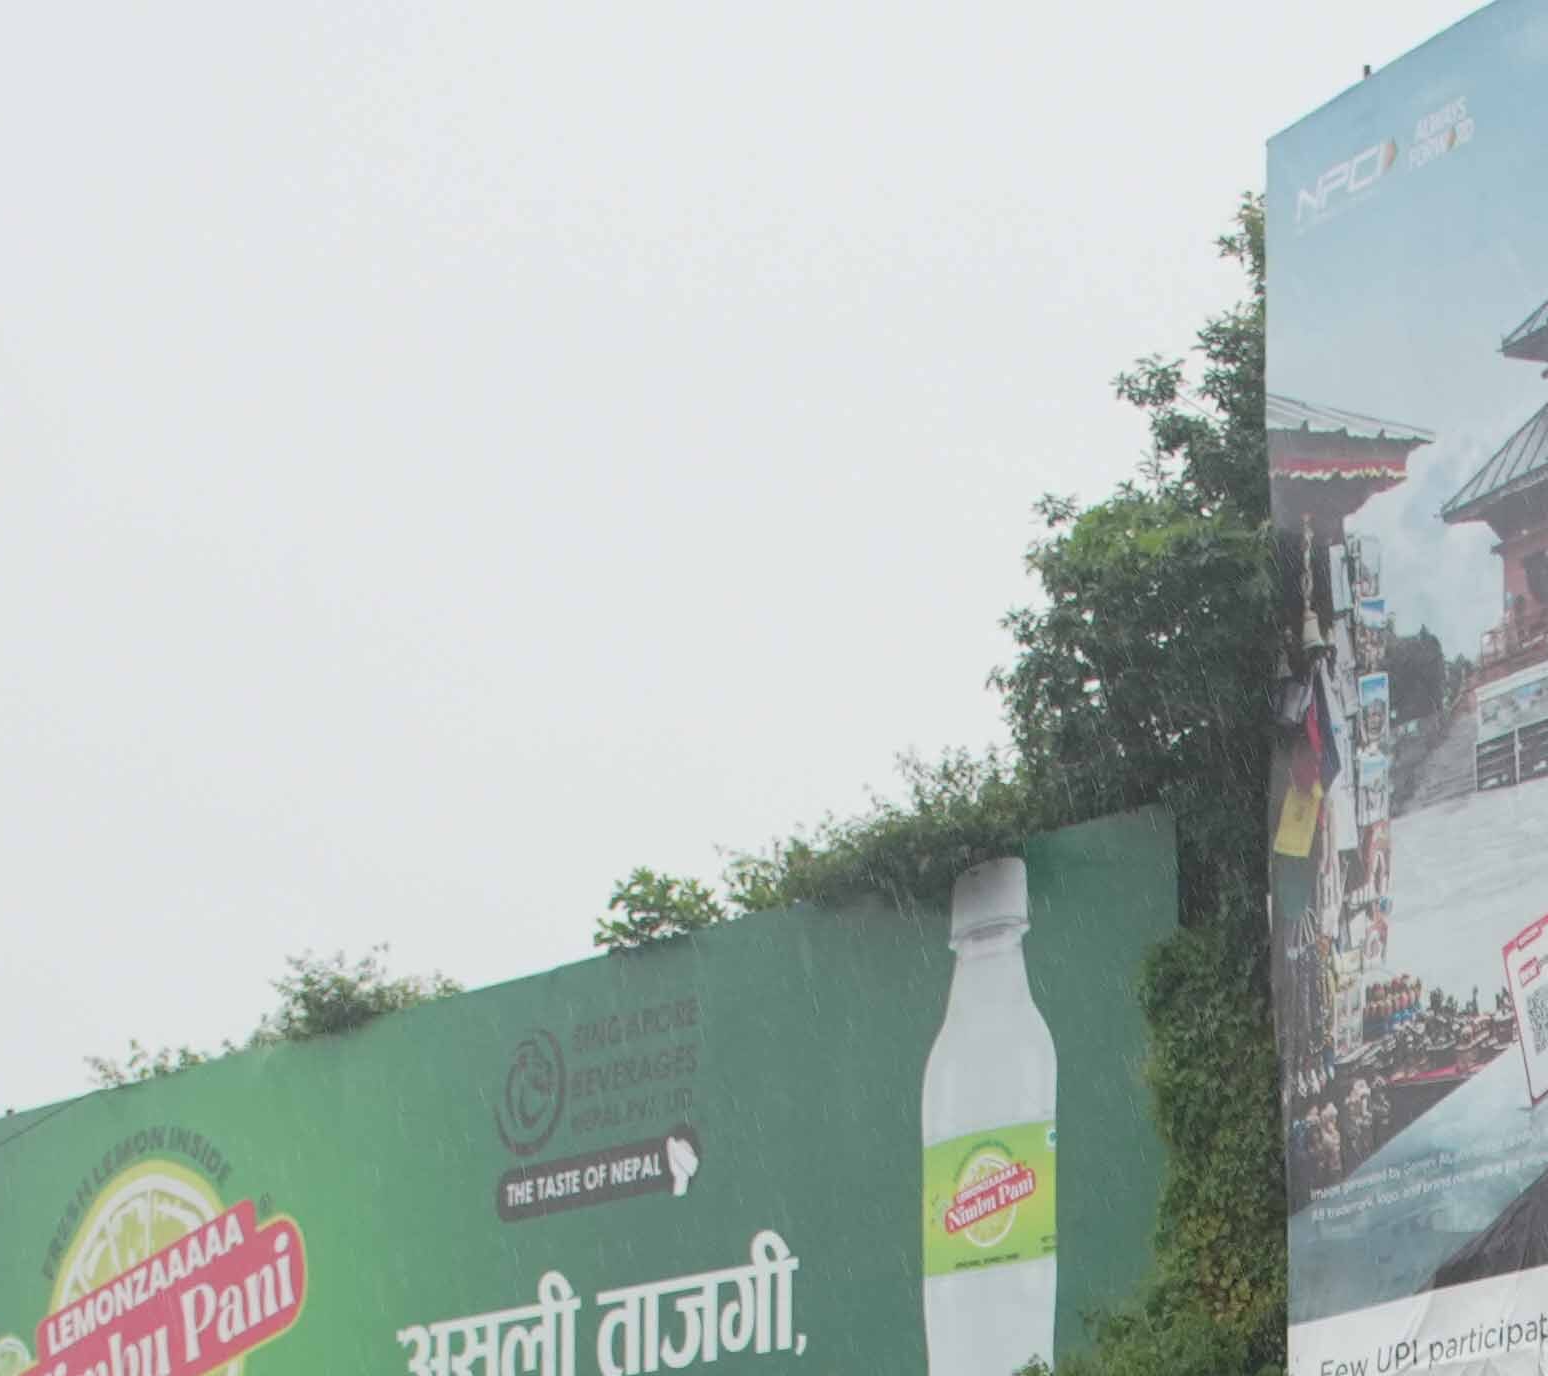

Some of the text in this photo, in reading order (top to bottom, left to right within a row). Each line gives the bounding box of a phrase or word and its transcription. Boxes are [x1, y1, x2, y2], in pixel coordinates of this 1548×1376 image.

[506, 1152, 663, 1208] THE TASTE OF NEPAL
[46, 1212, 245, 1357] LEMONZAAAAA
[179, 1232, 297, 1363] Pani
[1376, 1340, 1418, 1374] UPI
